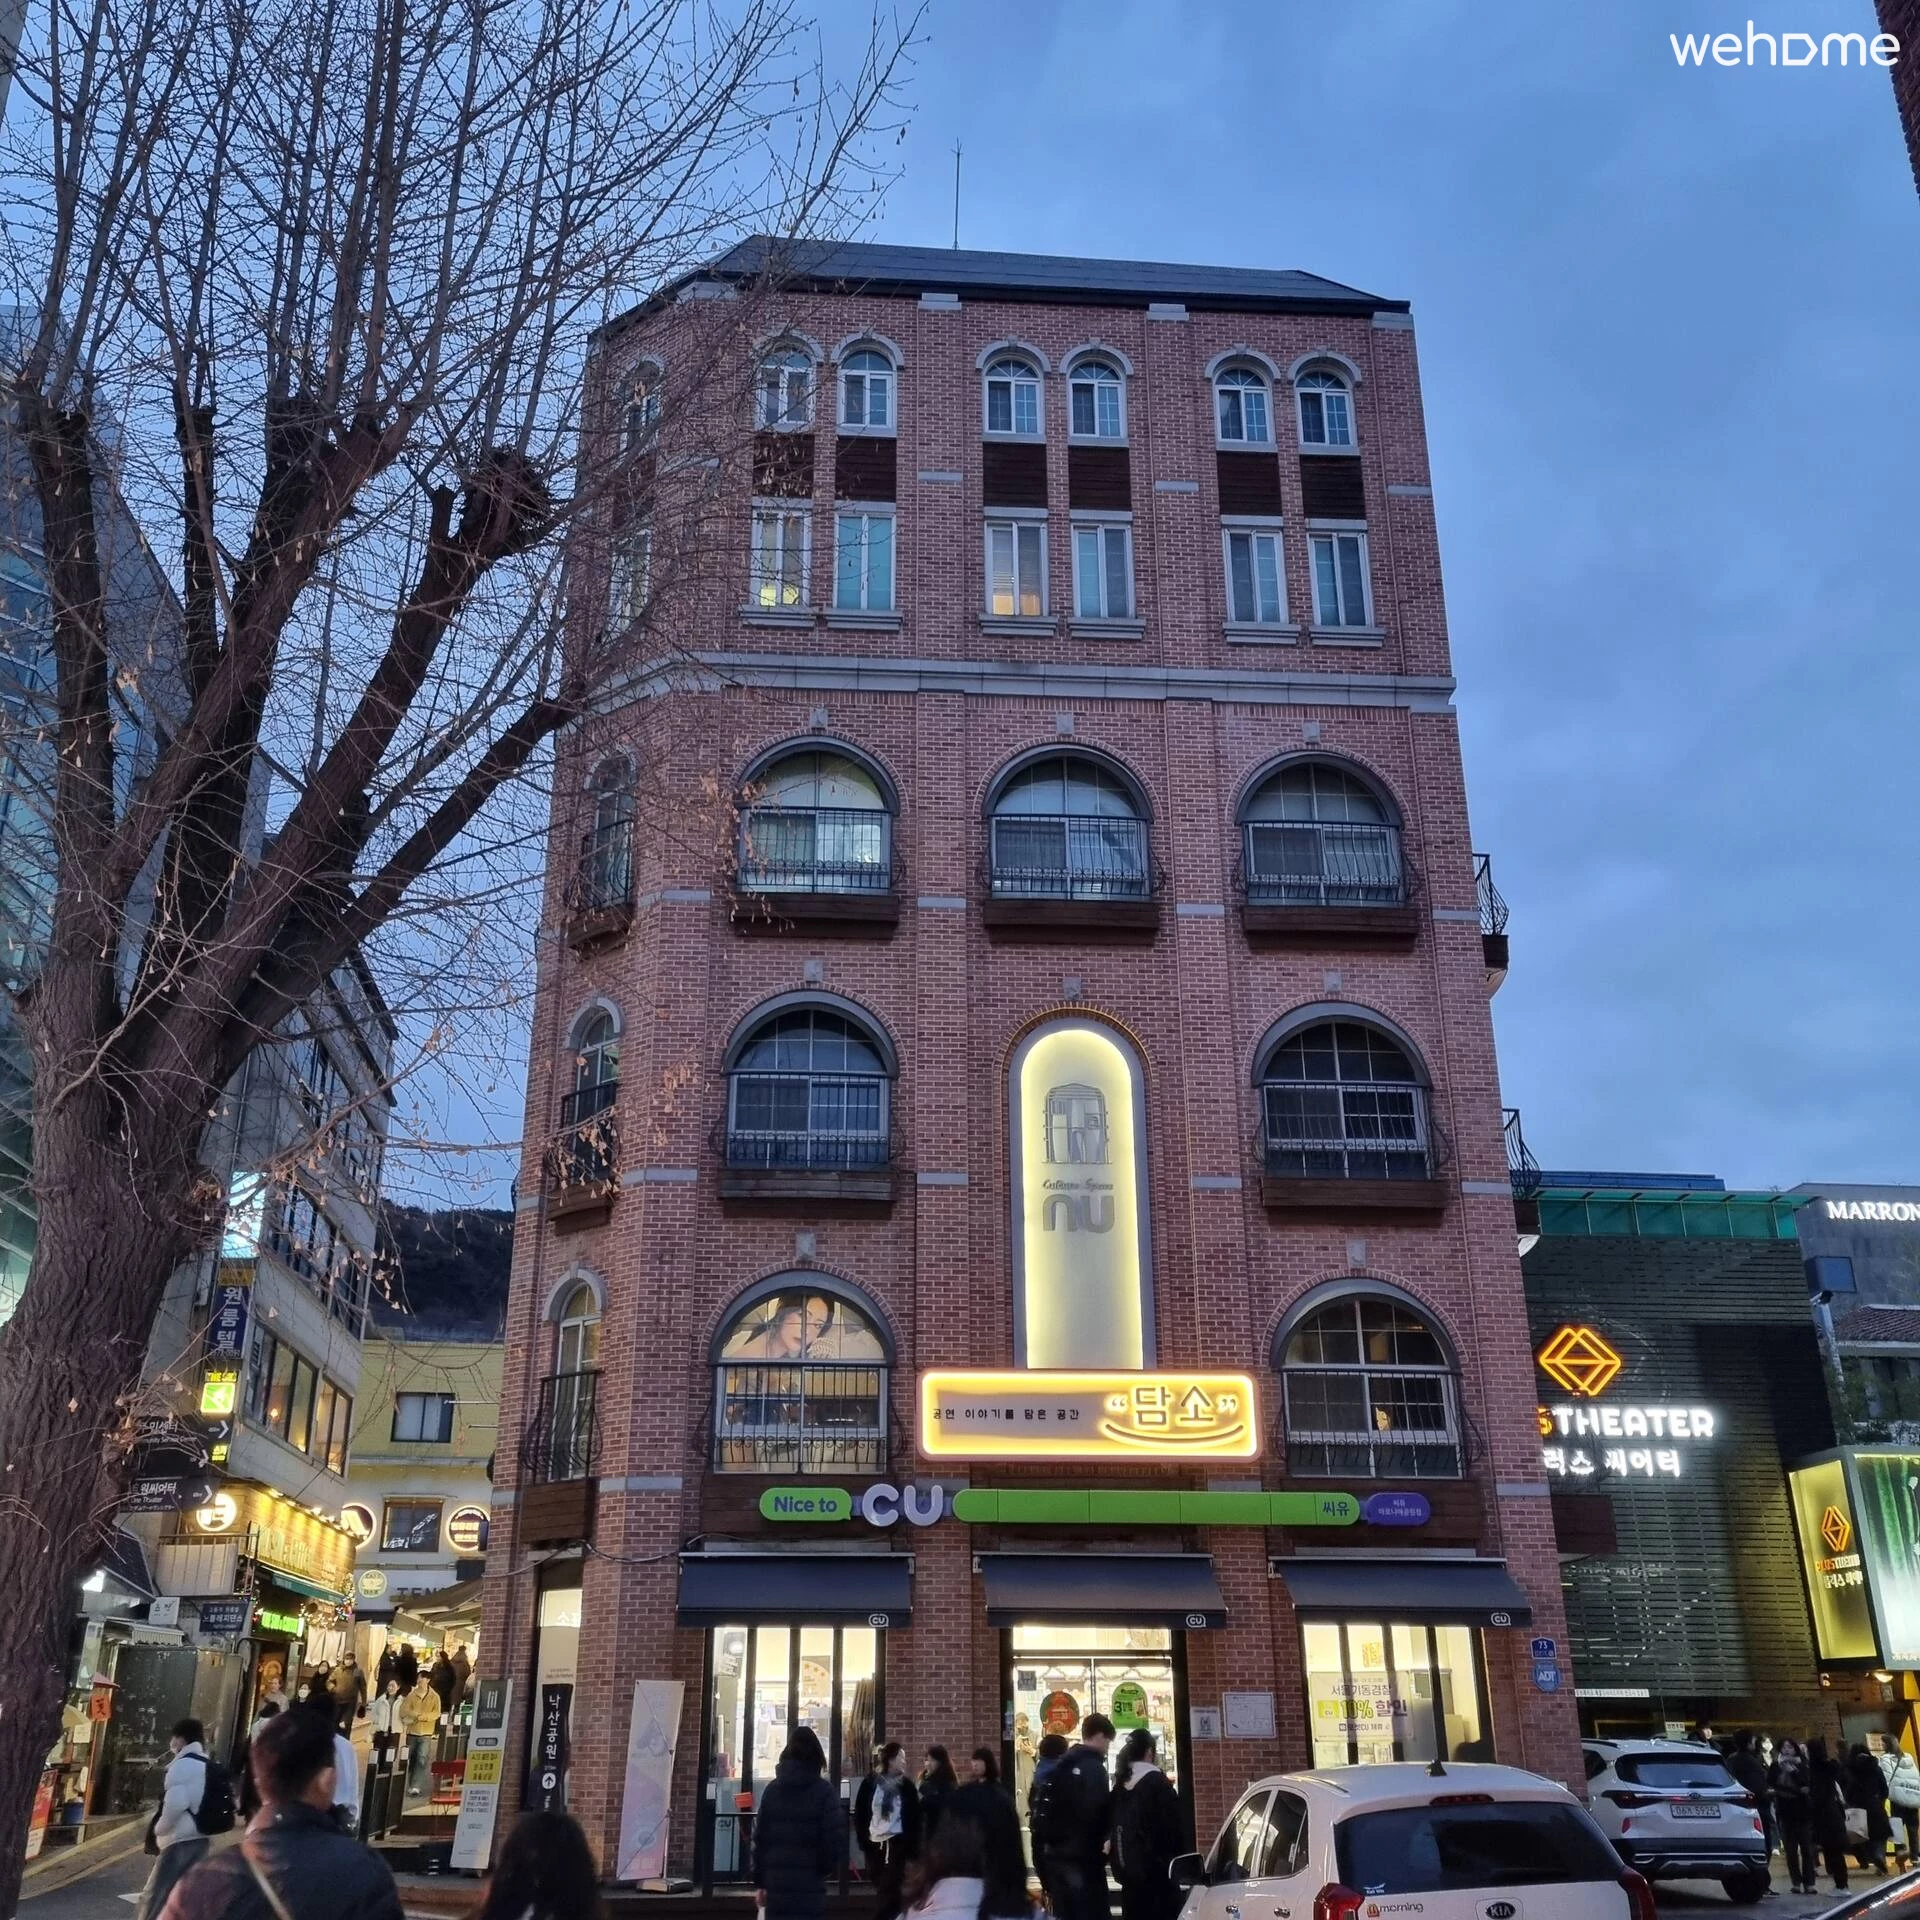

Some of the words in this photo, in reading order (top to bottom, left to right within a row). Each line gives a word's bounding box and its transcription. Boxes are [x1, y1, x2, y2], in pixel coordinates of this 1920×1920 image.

[933, 1408, 955, 1420] 공연
[965, 1408, 1014, 1420] 이야기를
[1024, 1408, 1047, 1420] 담은
[1057, 1408, 1080, 1420] 공간
[773, 1496, 813, 1513] Nice
[819, 1497, 837, 1513] to
[862, 1483, 943, 1527] CU
[1324, 1501, 1349, 1516] 씨유
[1537, 1670, 1557, 1682] ADT
[1340, 1699, 1374, 1719] 10%
[1375, 1699, 1408, 1717] 할인
[545, 1693, 561, 1760] 낙산공원
[1379, 1902, 1424, 1912] morning
[1490, 1905, 1511, 1917] KIA
